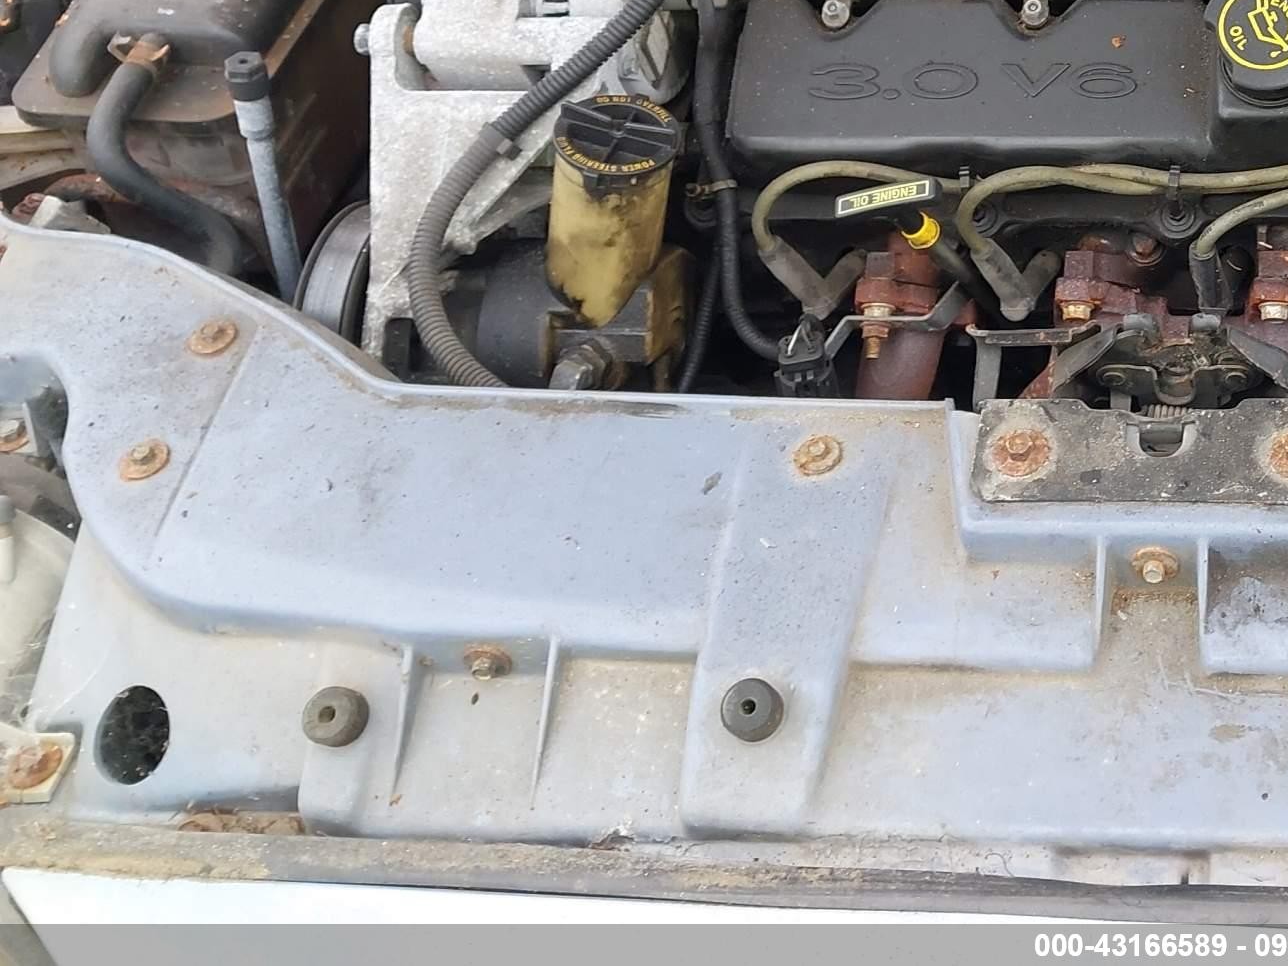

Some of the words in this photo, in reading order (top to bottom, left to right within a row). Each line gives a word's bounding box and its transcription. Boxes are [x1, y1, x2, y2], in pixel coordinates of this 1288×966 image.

[1229, 25, 1248, 51] OIL
[808, 63, 979, 100] 3.0
[1000, 63, 1138, 99] V6
[573, 152, 617, 173] STEERING
[621, 158, 656, 172] POWER
[848, 197, 869, 208] OIL
[871, 185, 918, 204] ENGINE
